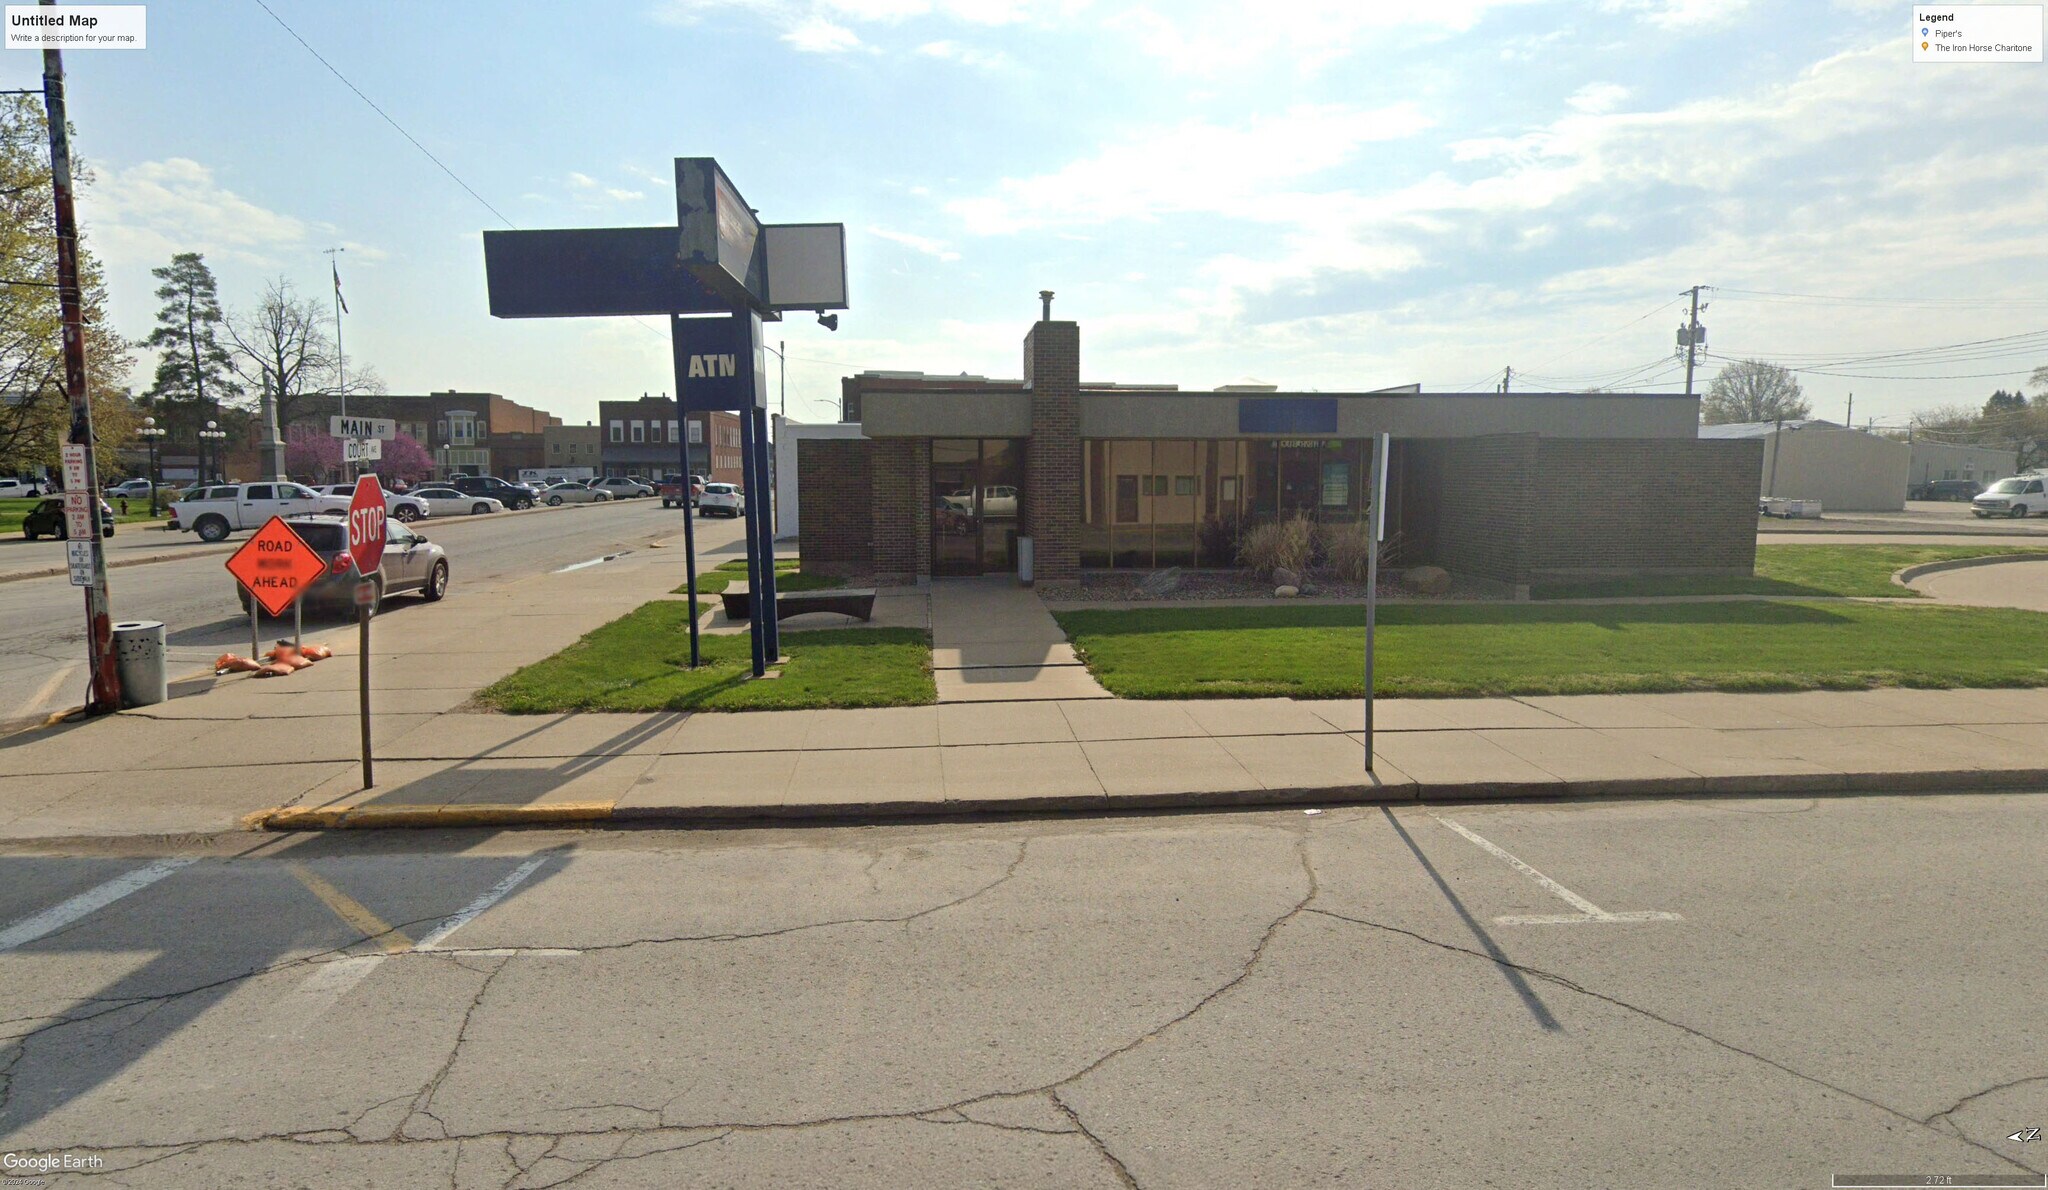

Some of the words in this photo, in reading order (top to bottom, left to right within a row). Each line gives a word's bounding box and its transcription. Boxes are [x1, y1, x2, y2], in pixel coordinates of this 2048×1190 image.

[341, 419, 373, 436] MAIN
[377, 425, 385, 433] ST
[348, 442, 369, 458] COURT
[71, 496, 82, 505] NO
[351, 505, 385, 546] STOP
[257, 540, 293, 552] ROAD
[252, 577, 298, 589] AHEAD
